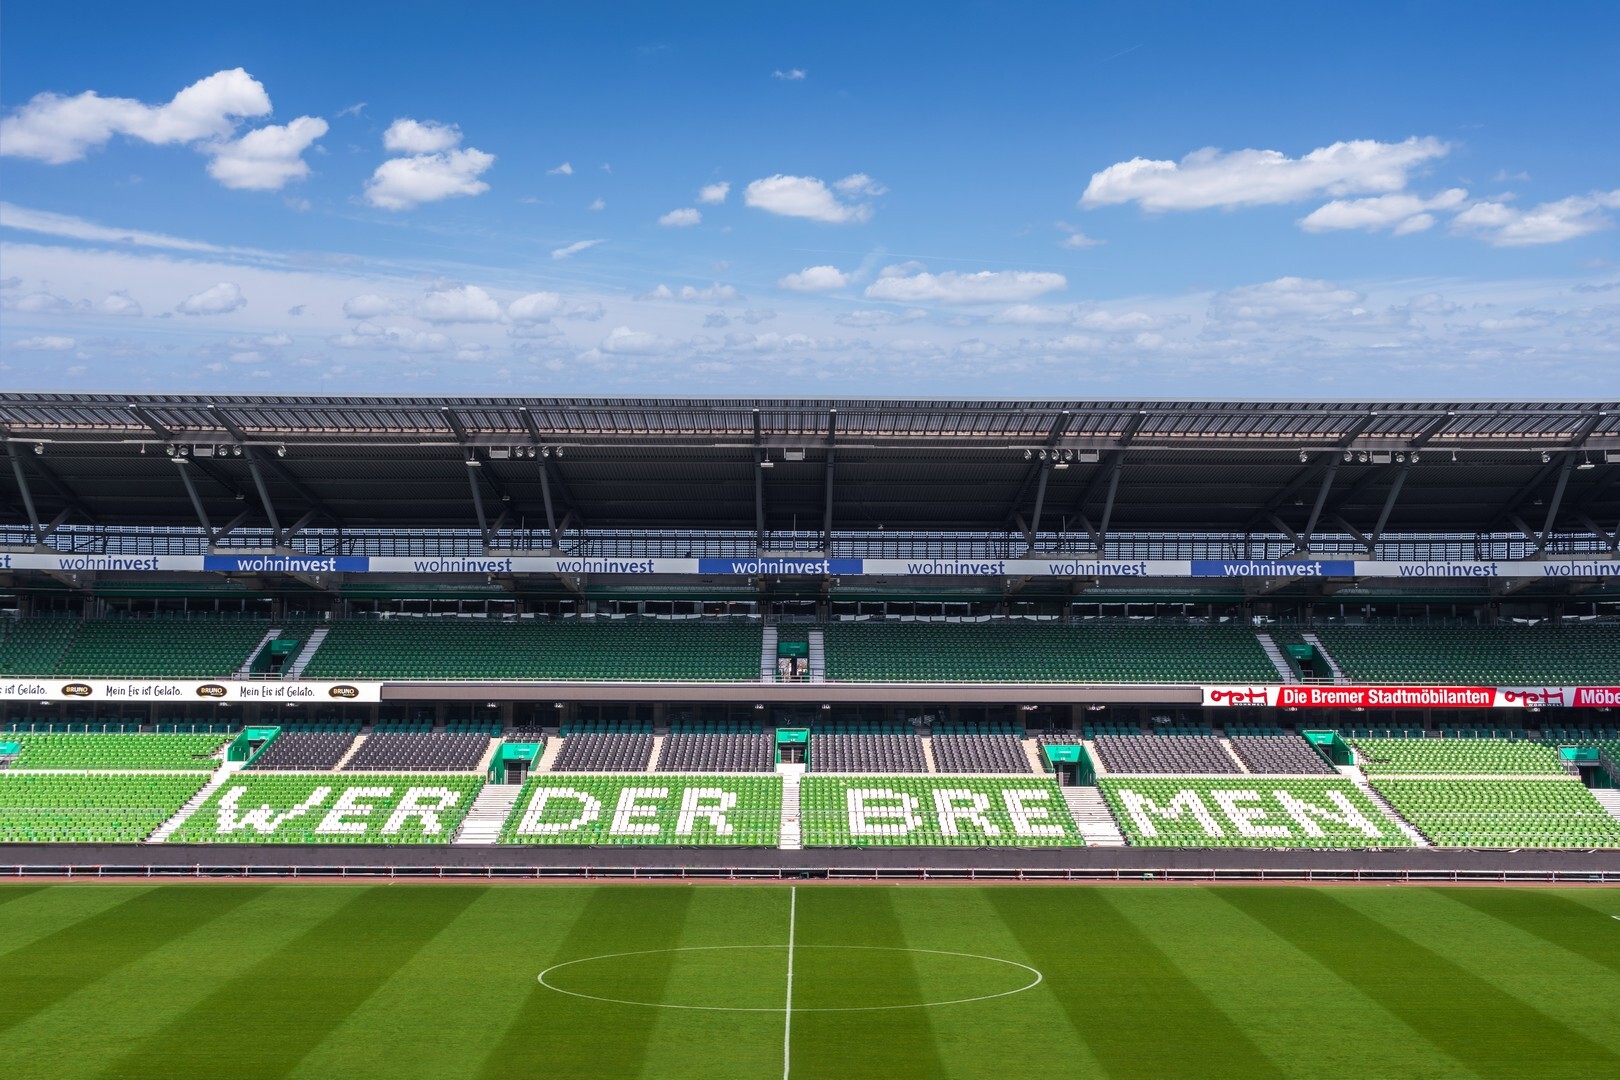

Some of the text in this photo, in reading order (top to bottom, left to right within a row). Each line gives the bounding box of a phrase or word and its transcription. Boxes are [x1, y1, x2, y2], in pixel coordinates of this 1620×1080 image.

[59, 554, 159, 570] wohninvest
[237, 556, 336, 571] wohninvest
[414, 557, 512, 572] wohninvest
[556, 557, 654, 573] wohninvest
[732, 558, 830, 574] wohninvest
[908, 559, 1005, 575] wohninvest
[1049, 560, 1147, 575] wohninvest
[1224, 561, 1322, 576] wohninvest
[1399, 561, 1498, 576] wohninvest
[5, 684, 15, 694] ist
[18, 684, 47, 695] Gelato.
[106, 685, 182, 697] Mein Eis ist Gelato.
[240, 686, 315, 697] Mein Eis ist Gelato.
[1210, 687, 1268, 706] opti
[1284, 689, 1489, 704] Die Bremer Stadtmöbilanten
[1504, 687, 1564, 707] opti
[1580, 689, 1620, 704] Möbe
